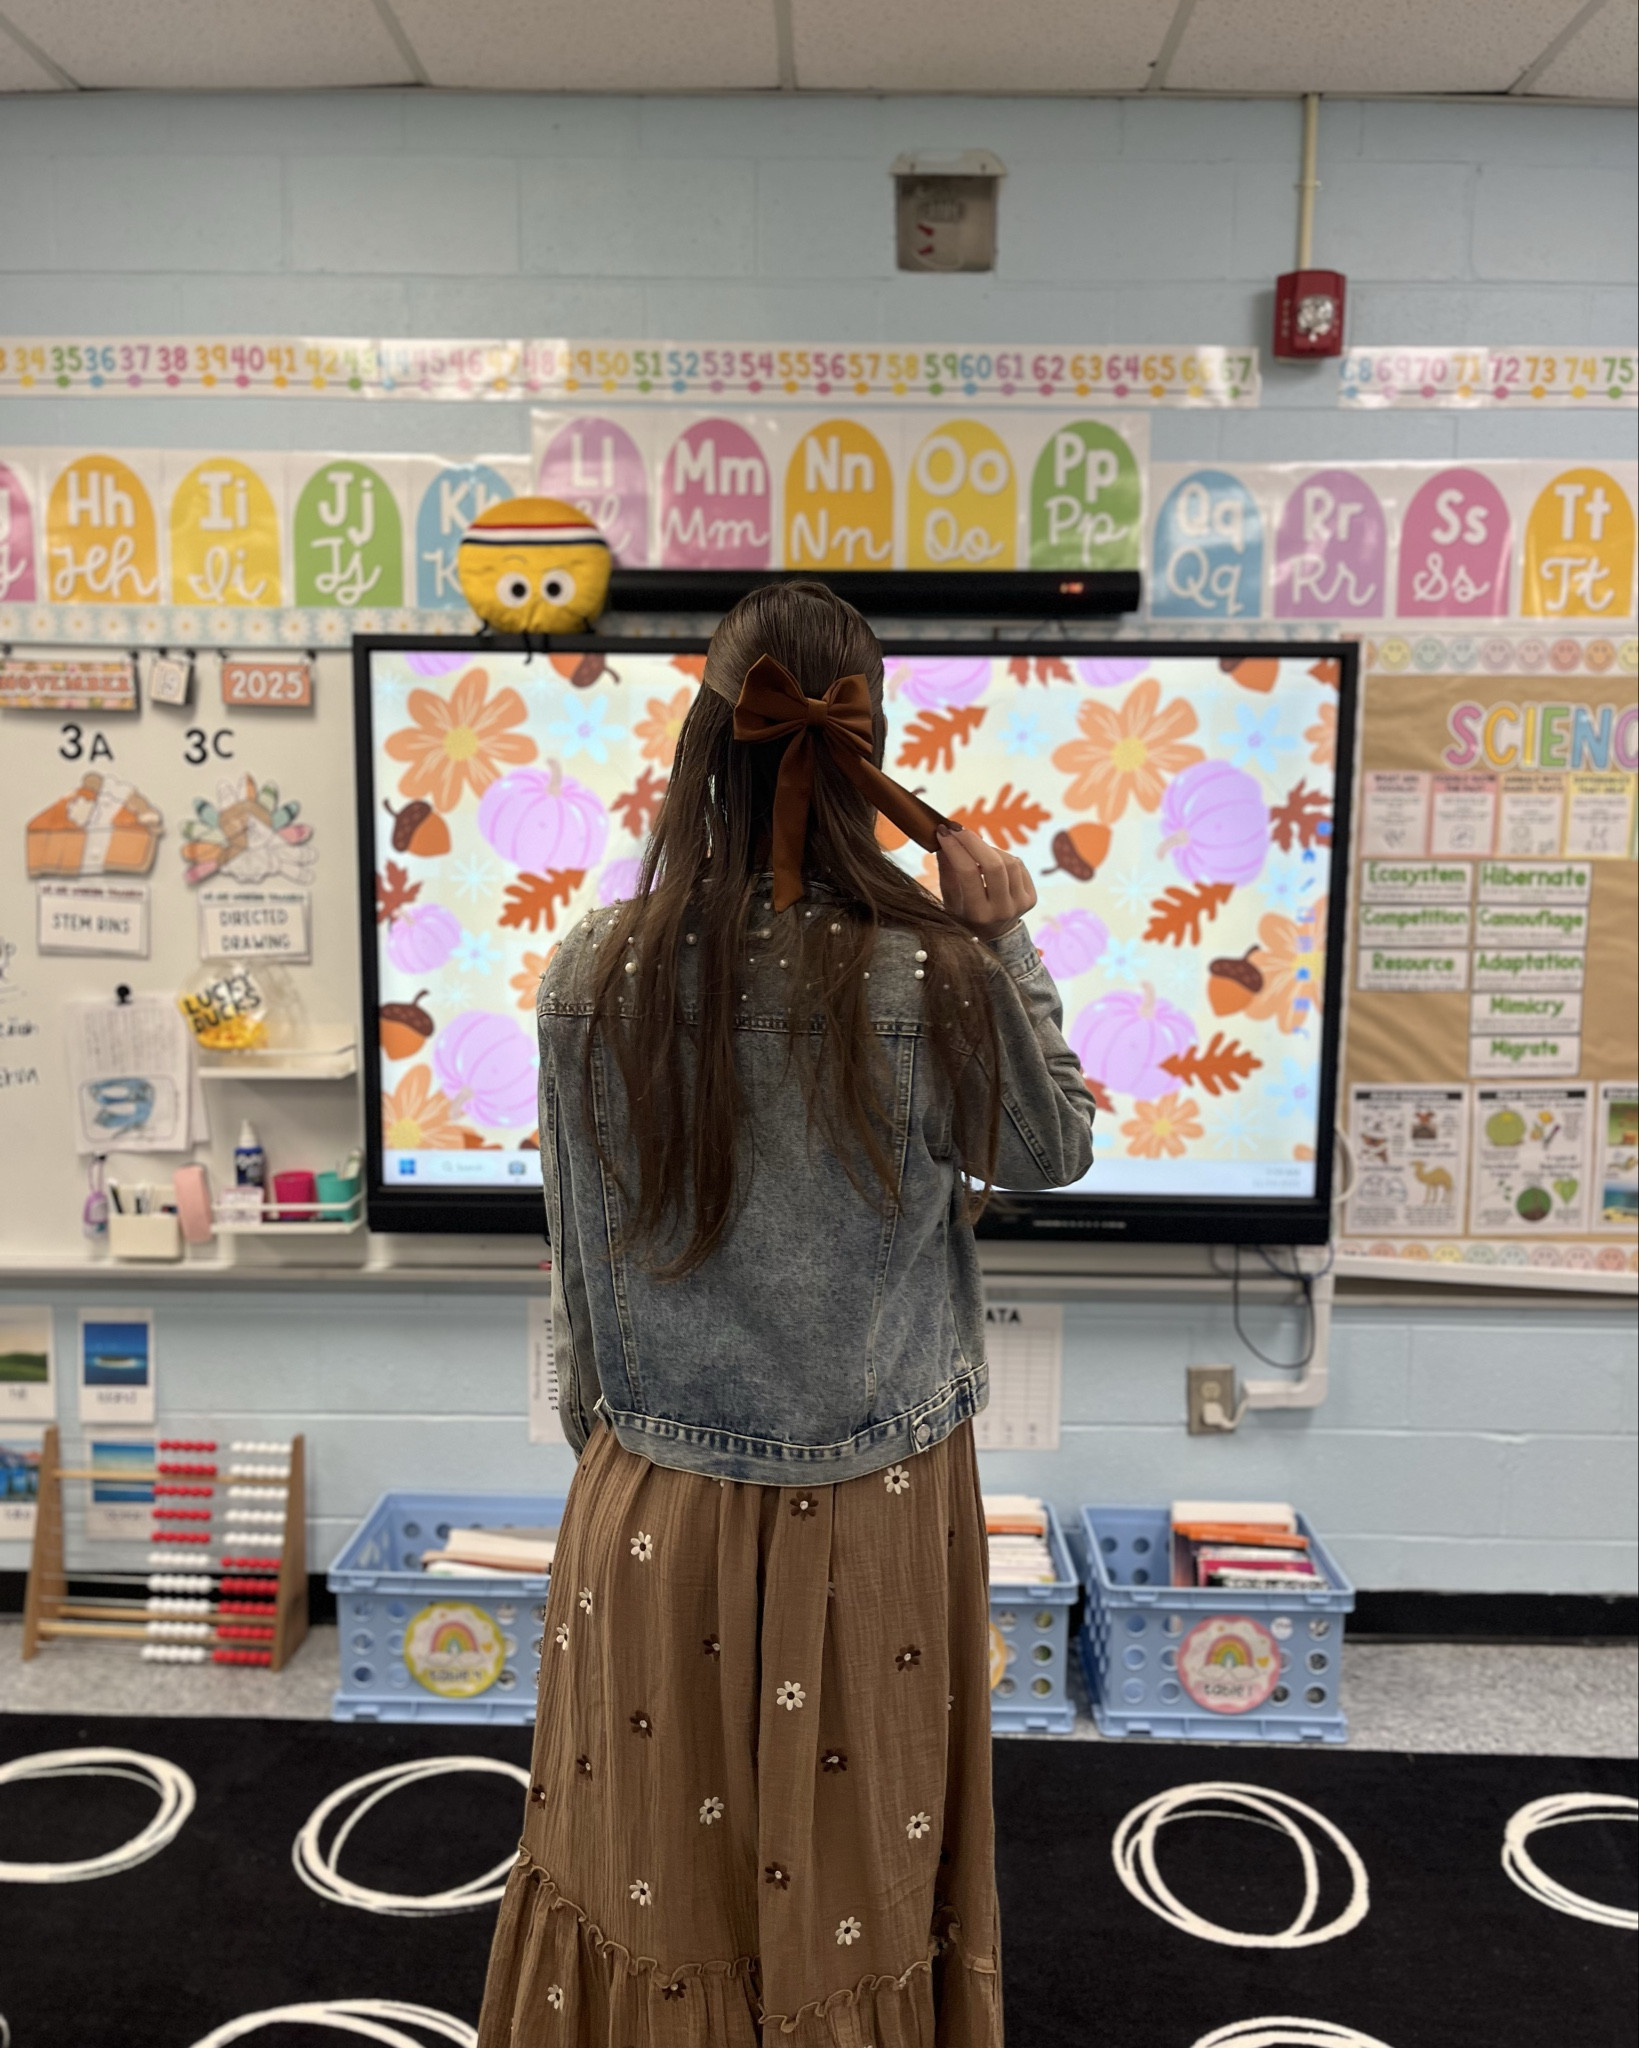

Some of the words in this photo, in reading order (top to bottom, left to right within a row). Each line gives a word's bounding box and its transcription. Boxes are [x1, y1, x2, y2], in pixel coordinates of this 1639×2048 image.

[15, 347, 45, 373] 34
[51, 346, 82, 373] 35
[85, 346, 115, 373] 36
[120, 345, 150, 373] 37
[157, 346, 188, 372] 38
[196, 345, 227, 372] 39
[231, 346, 265, 372] 40
[268, 347, 296, 375] 41
[305, 347, 337, 374] 42
[596, 351, 628, 376] 50
[634, 350, 662, 376] 51
[668, 350, 699, 376] 52
[703, 350, 735, 376] 53
[740, 351, 773, 377] 54
[779, 351, 811, 377] 55
[813, 352, 845, 377] 56
[849, 353, 881, 379] 57
[887, 353, 918, 379] 58
[925, 353, 958, 379] 59
[960, 354, 991, 379] 60
[996, 354, 1024, 379] 61
[1032, 355, 1065, 380] 62
[1071, 354, 1103, 380] 63
[1107, 355, 1139, 381] 64
[1143, 355, 1175, 381] 65
[1415, 357, 1447, 383] 70
[1488, 356, 1520, 383] 72
[1526, 357, 1557, 383] 73
[1564, 356, 1597, 383] 74
[1602, 356, 1634, 383] 75
[571, 434, 612, 488] Ll
[674, 440, 765, 495] Mm
[805, 437, 874, 492] Nn
[917, 435, 1009, 495] Oo
[1055, 432, 1118, 502] Pp
[67, 471, 135, 528] Hh
[199, 471, 248, 530] Ii
[319, 471, 374, 545] Jj
[1176, 482, 1244, 553] Qq
[1303, 486, 1363, 543] Rr
[1431, 489, 1490, 545] Ss
[1555, 484, 1610, 541] Tt
[662, 508, 770, 549] Mm
[792, 509, 892, 563] Nn
[1047, 495, 1130, 565] Pp
[1166, 546, 1243, 614] Qq
[1289, 554, 1376, 608] Rr
[230, 669, 304, 700] 2025
[1368, 862, 1467, 887] Ecosystem
[1481, 866, 1587, 887] Hibernate
[52, 912, 92, 933] STEM
[220, 910, 287, 927] DIRECTED
[1361, 908, 1468, 928] Competition
[1478, 909, 1583, 934] Camouflage
[221, 934, 291, 951] DRAWING
[1372, 952, 1455, 972] Resource
[1477, 953, 1582, 975] Adaptation
[1490, 997, 1566, 1018] Mimicry
[1490, 1041, 1560, 1061] Migrate
[985, 1309, 1021, 1324] ATA
